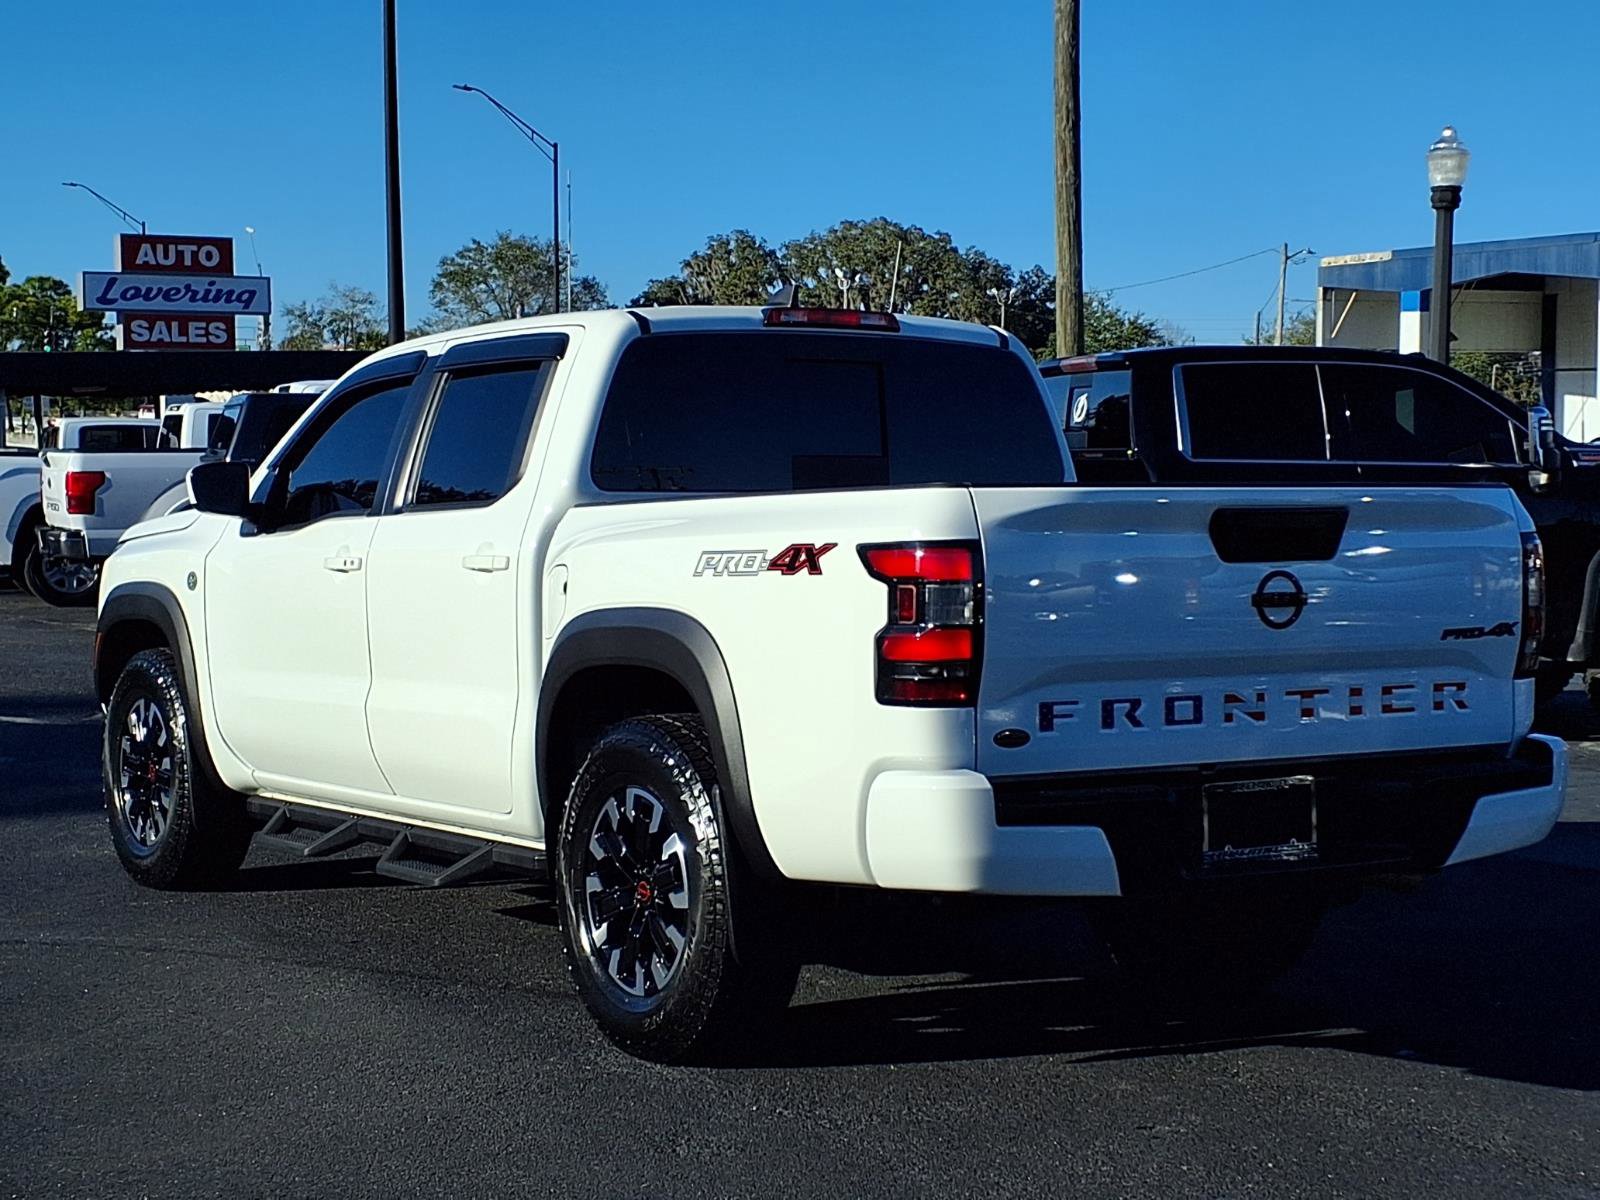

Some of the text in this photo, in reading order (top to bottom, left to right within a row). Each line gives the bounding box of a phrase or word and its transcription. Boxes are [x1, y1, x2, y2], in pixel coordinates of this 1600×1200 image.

[136, 243, 220, 267] AUTO
[96, 276, 258, 310] Lovering
[131, 319, 228, 344] SALES
[1038, 681, 1470, 733] FRONTIER
